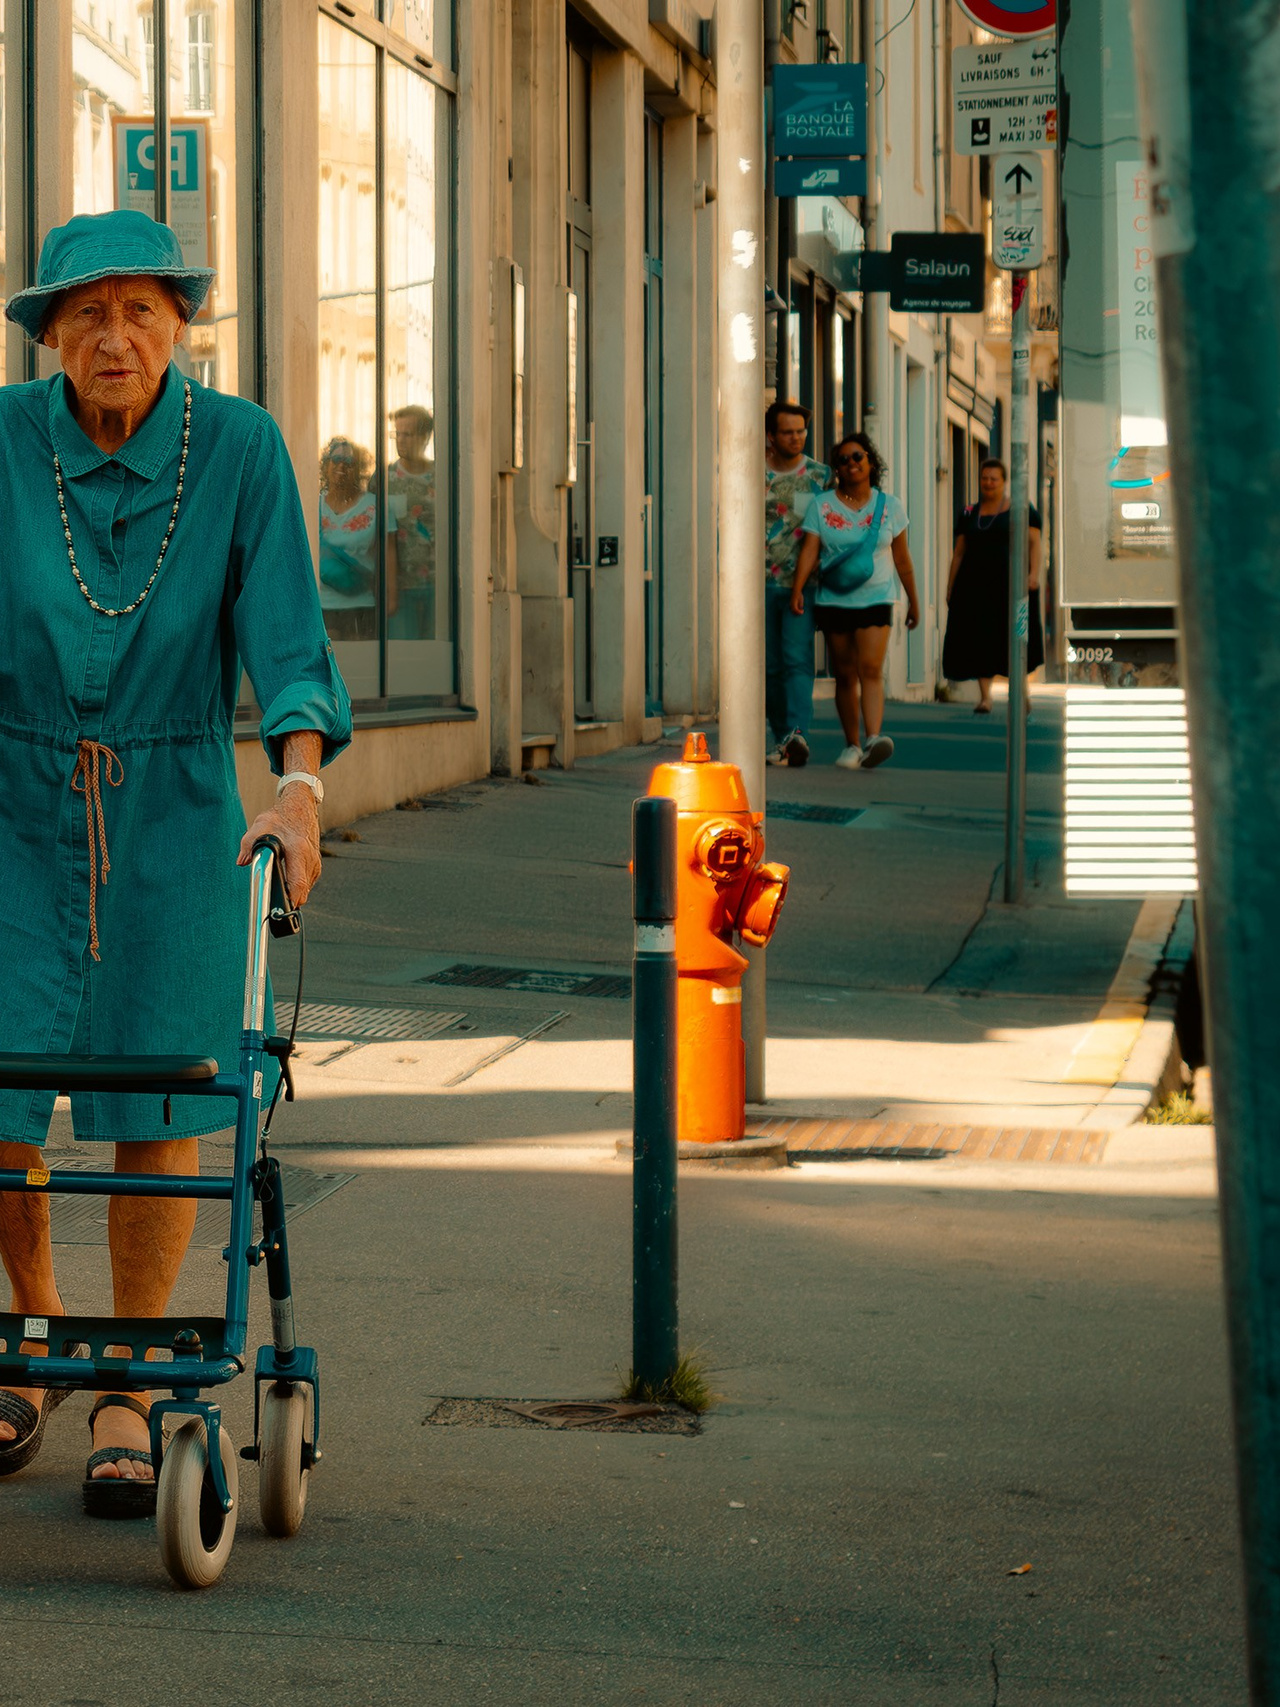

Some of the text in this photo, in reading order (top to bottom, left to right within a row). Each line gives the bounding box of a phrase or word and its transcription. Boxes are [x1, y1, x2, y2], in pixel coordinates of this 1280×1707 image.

[977, 52, 1002, 64] SAUF
[960, 67, 1020, 83] LIVRAISONS
[834, 101, 854, 112] LA
[957, 95, 1029, 111] STATIONNEMENT
[786, 113, 854, 124] BANQUE
[1008, 116, 1025, 128] 12H
[786, 125, 854, 137] POSTALE
[999, 130, 1042, 143] MAXI 30
[903, 298, 930, 308] Agence
[941, 300, 971, 309] voyages
